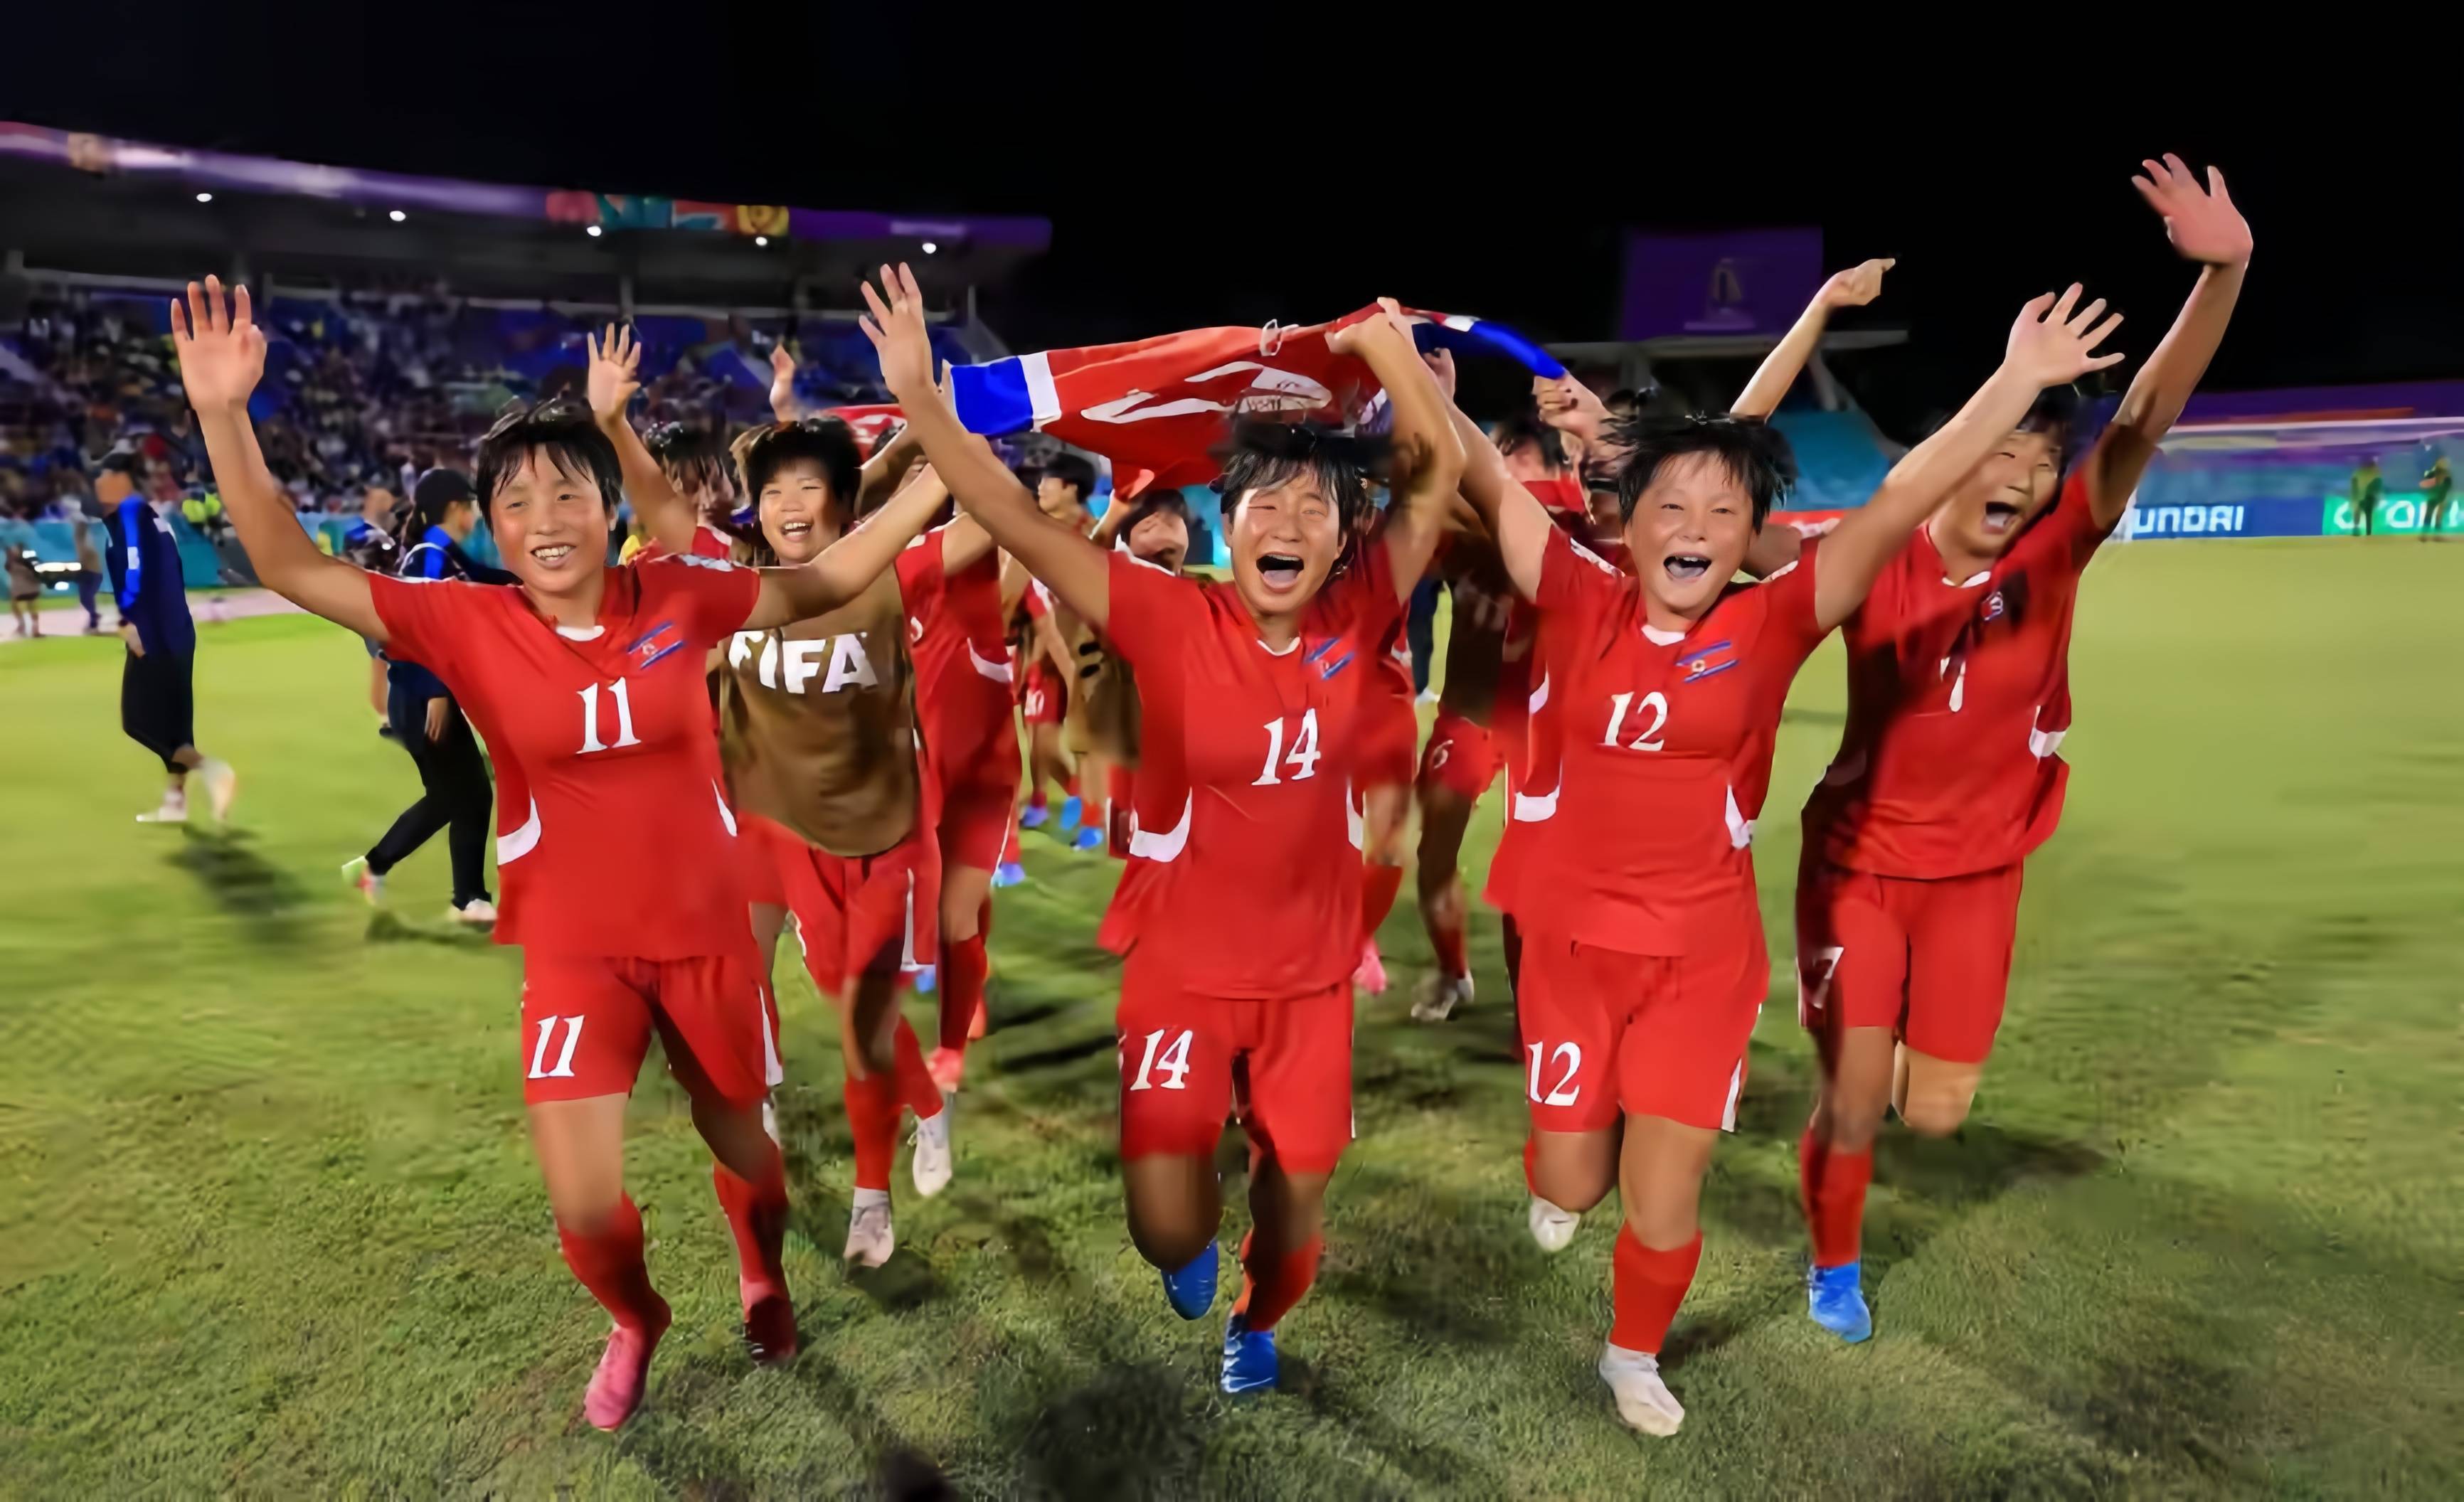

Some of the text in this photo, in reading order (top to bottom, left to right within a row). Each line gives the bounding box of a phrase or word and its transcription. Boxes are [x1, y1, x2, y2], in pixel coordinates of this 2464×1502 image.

[728, 630, 878, 694] FIFA
[575, 676, 642, 755] 11
[1251, 708, 1321, 786] 14
[1603, 691, 1668, 752] 12
[527, 1015, 585, 1079] 11
[1130, 1028, 1194, 1091] 14
[1526, 1040, 1582, 1107] 12
